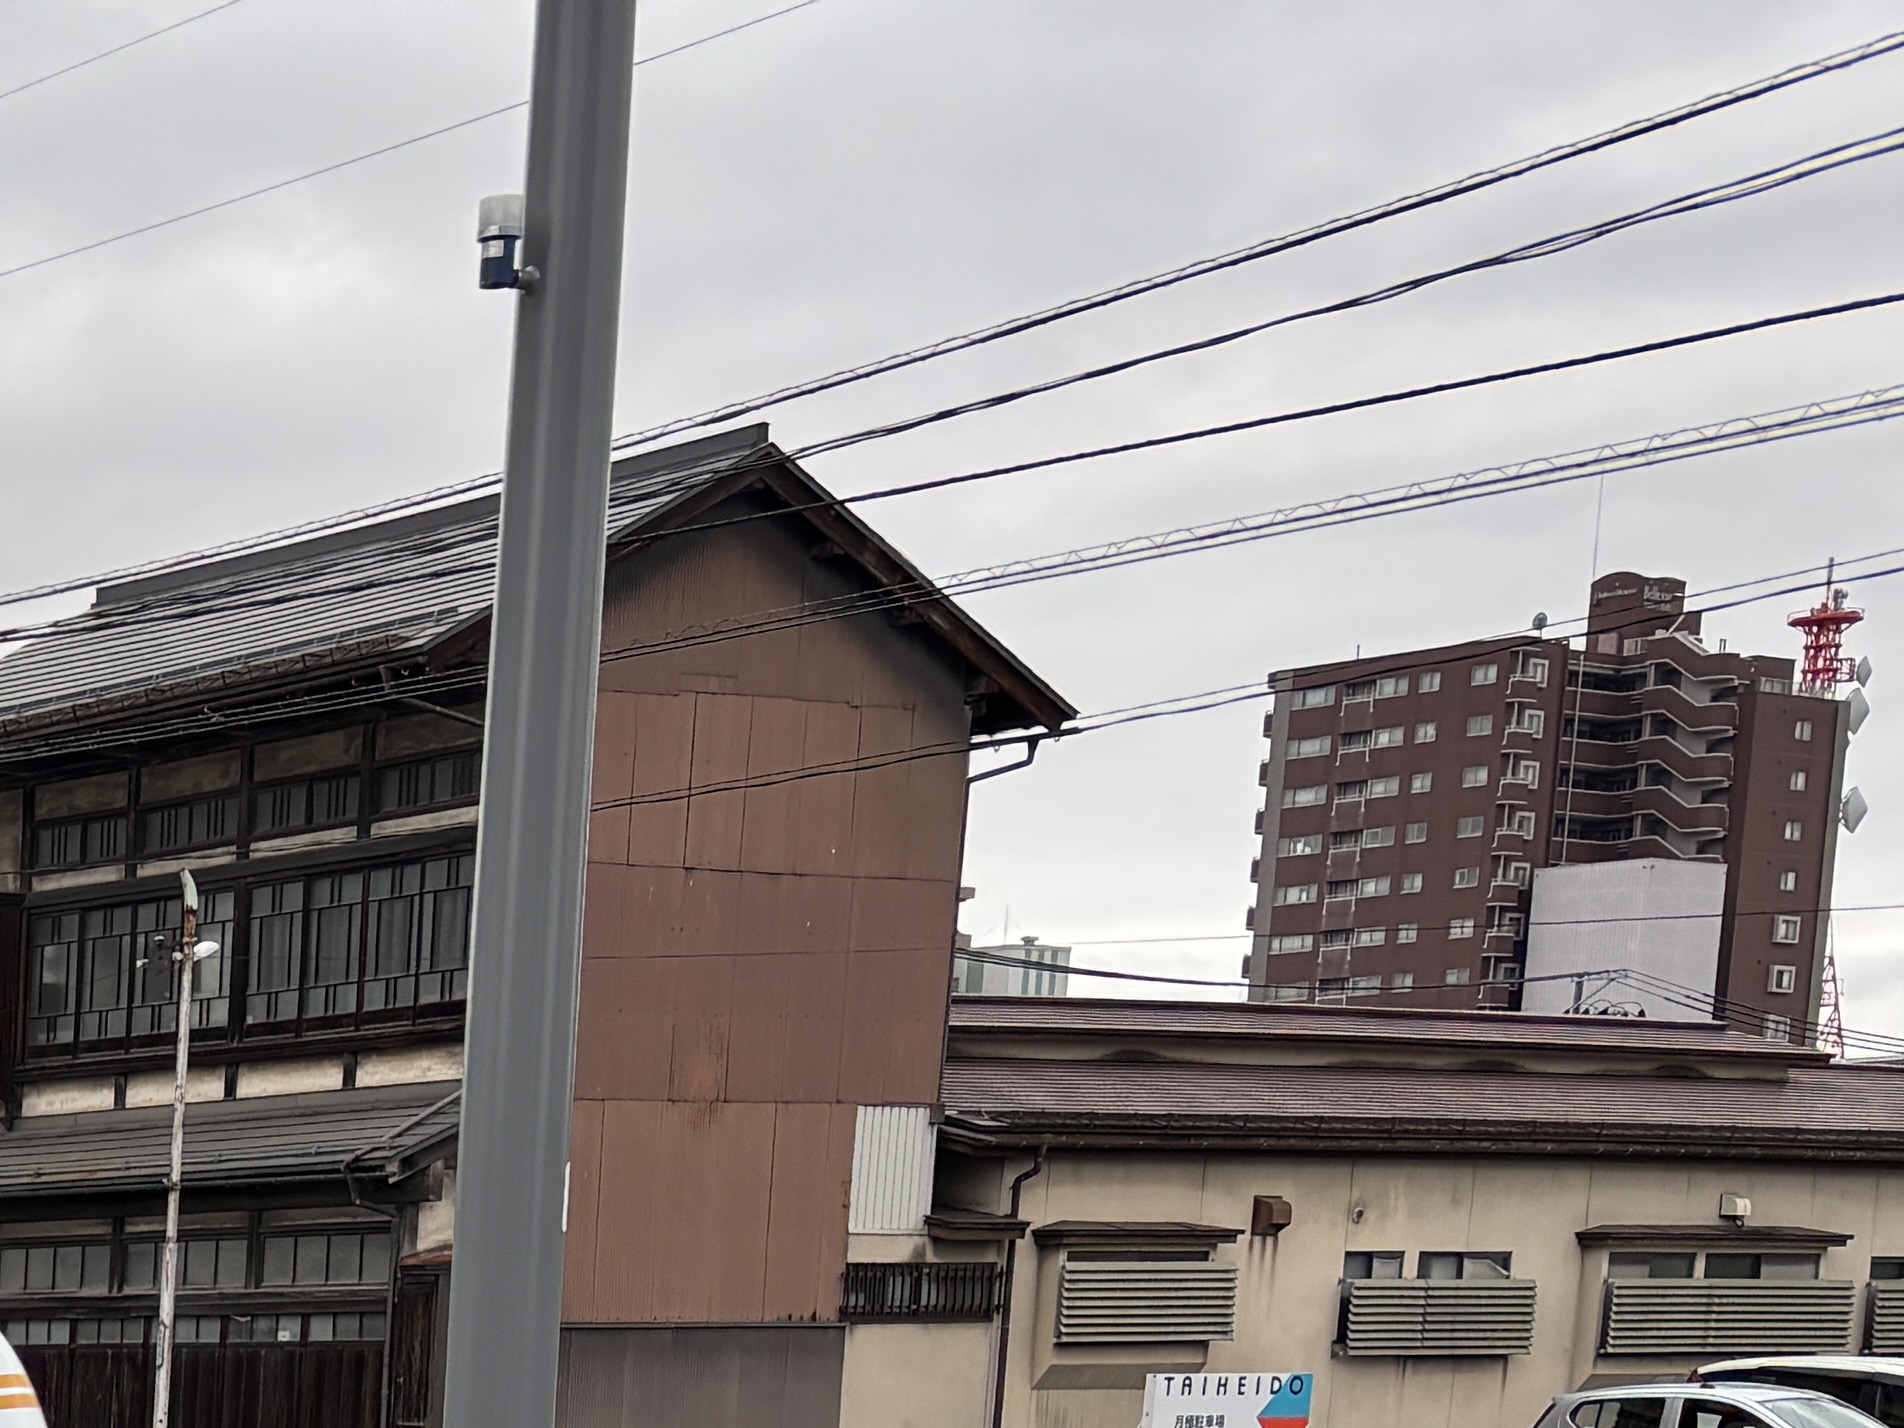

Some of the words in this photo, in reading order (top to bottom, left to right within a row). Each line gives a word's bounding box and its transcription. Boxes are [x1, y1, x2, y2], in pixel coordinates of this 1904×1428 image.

[1164, 1375, 1304, 1396] TAIHEIDO
[1174, 1414, 1225, 1428] 月極駐車場
